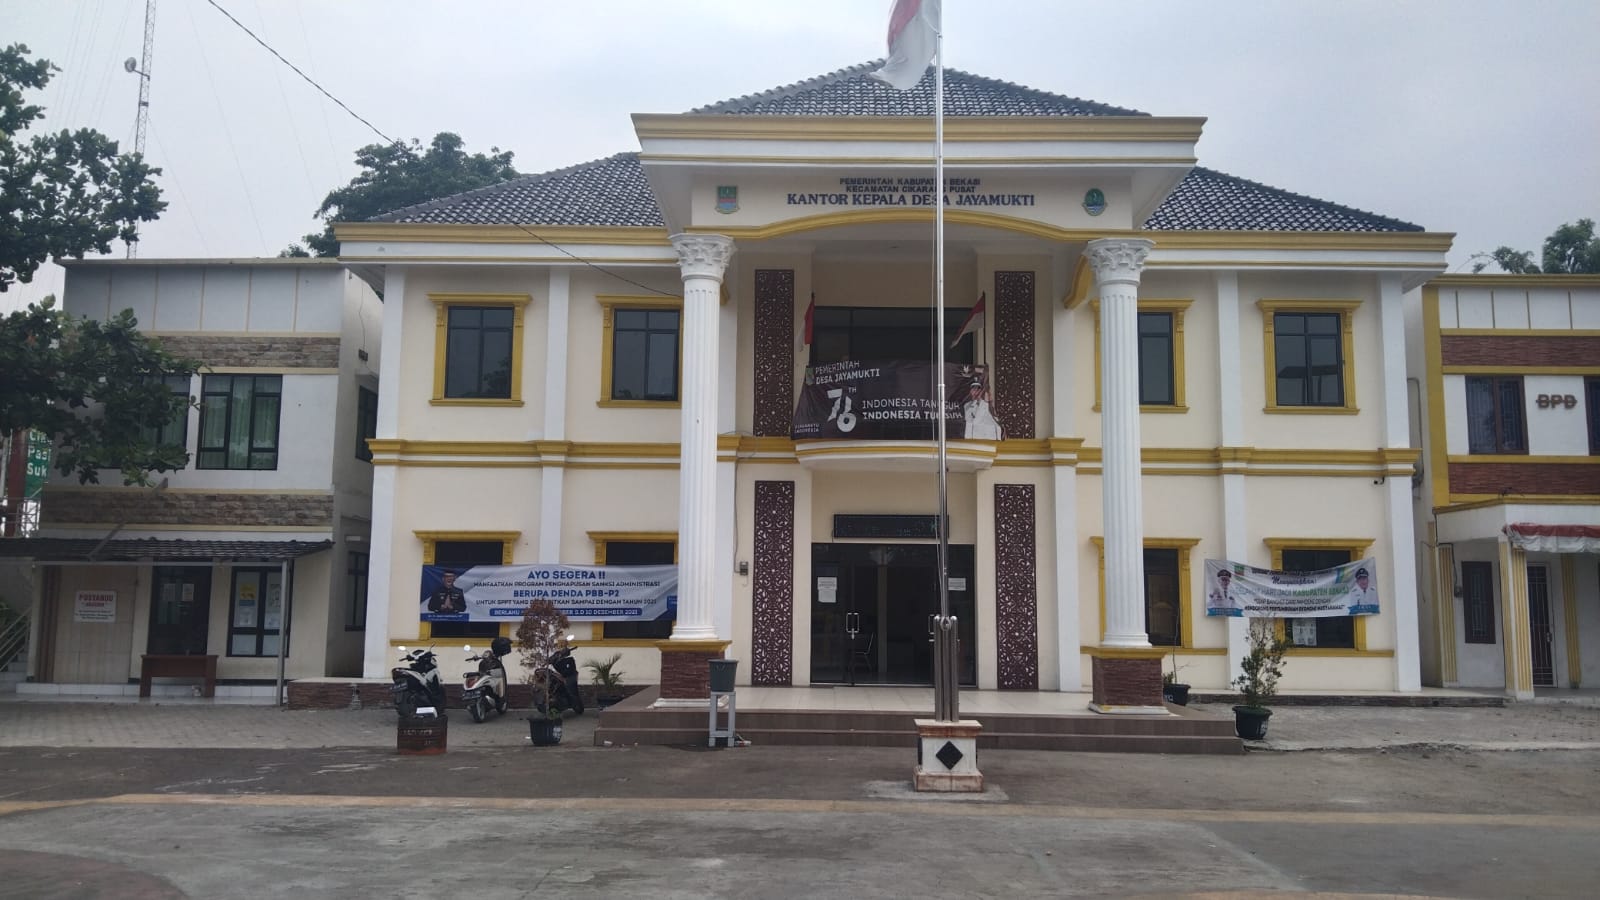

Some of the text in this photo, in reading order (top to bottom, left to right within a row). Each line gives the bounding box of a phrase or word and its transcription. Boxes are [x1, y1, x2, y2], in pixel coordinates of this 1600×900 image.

[840, 177, 894, 185] PEMERINTAH
[950, 178, 981, 186] BEKASI
[846, 185, 899, 193] KECAMATAN
[787, 194, 1035, 207] KANTOR KEPALA DESA JAYAMUKTI
[815, 361, 860, 375] PEMERINTAH
[815, 369, 881, 385] DESA JAYAMUKTI
[862, 398, 918, 409] INDONESIA
[1536, 394, 1578, 410] BPD
[862, 410, 921, 420] INDONESIA
[528, 571, 550, 580] AYO
[552, 571, 596, 580] SEGERA
[513, 589, 620, 598] BERUPA DENDA PBB-P2
